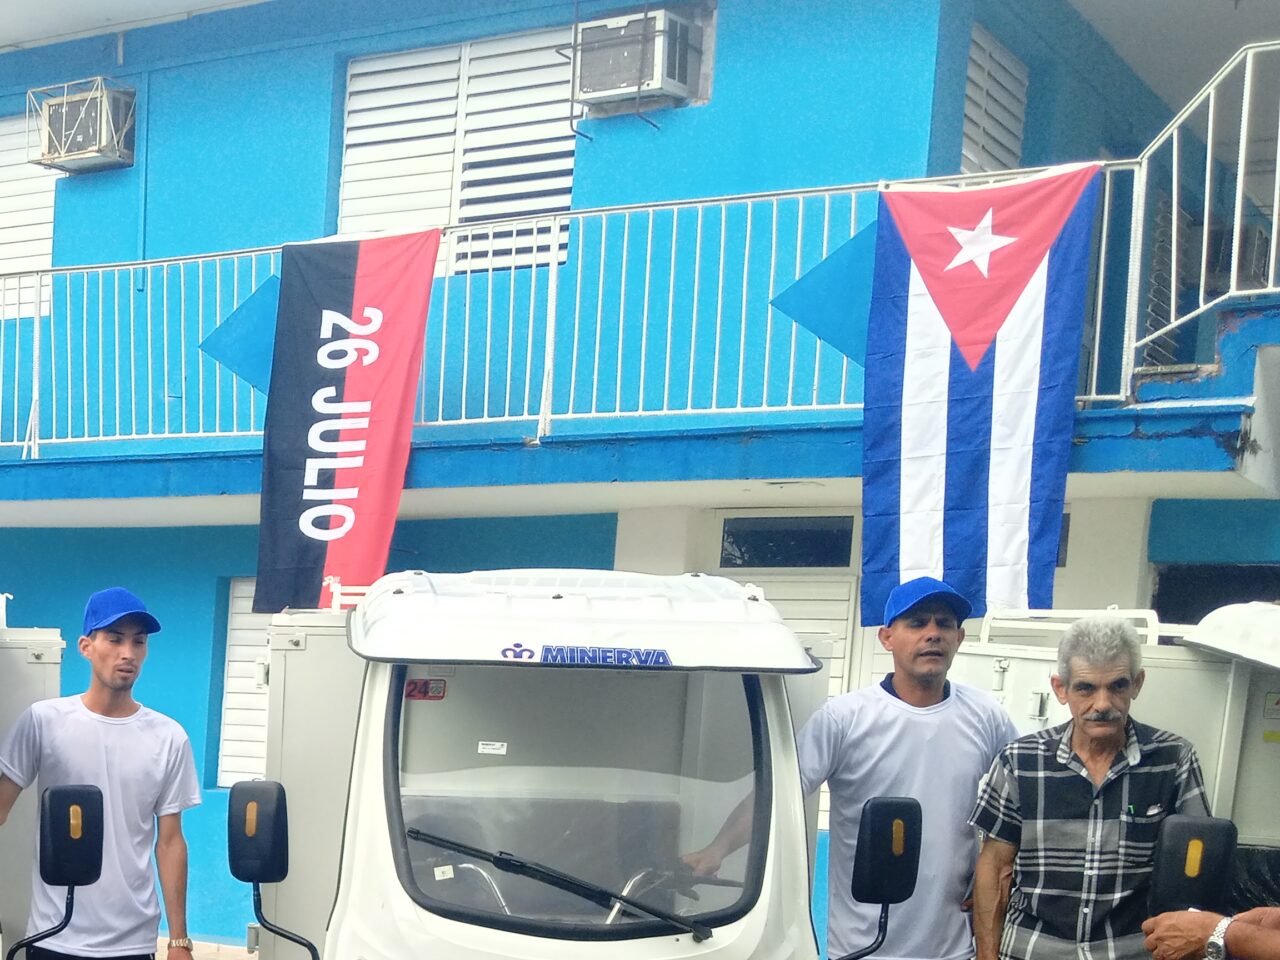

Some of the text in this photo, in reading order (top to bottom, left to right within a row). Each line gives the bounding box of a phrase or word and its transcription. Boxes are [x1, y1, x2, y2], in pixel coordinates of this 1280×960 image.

[298, 306, 384, 542] 26 JULIO
[539, 645, 673, 667] MINERVA
[406, 680, 429, 698] 24
